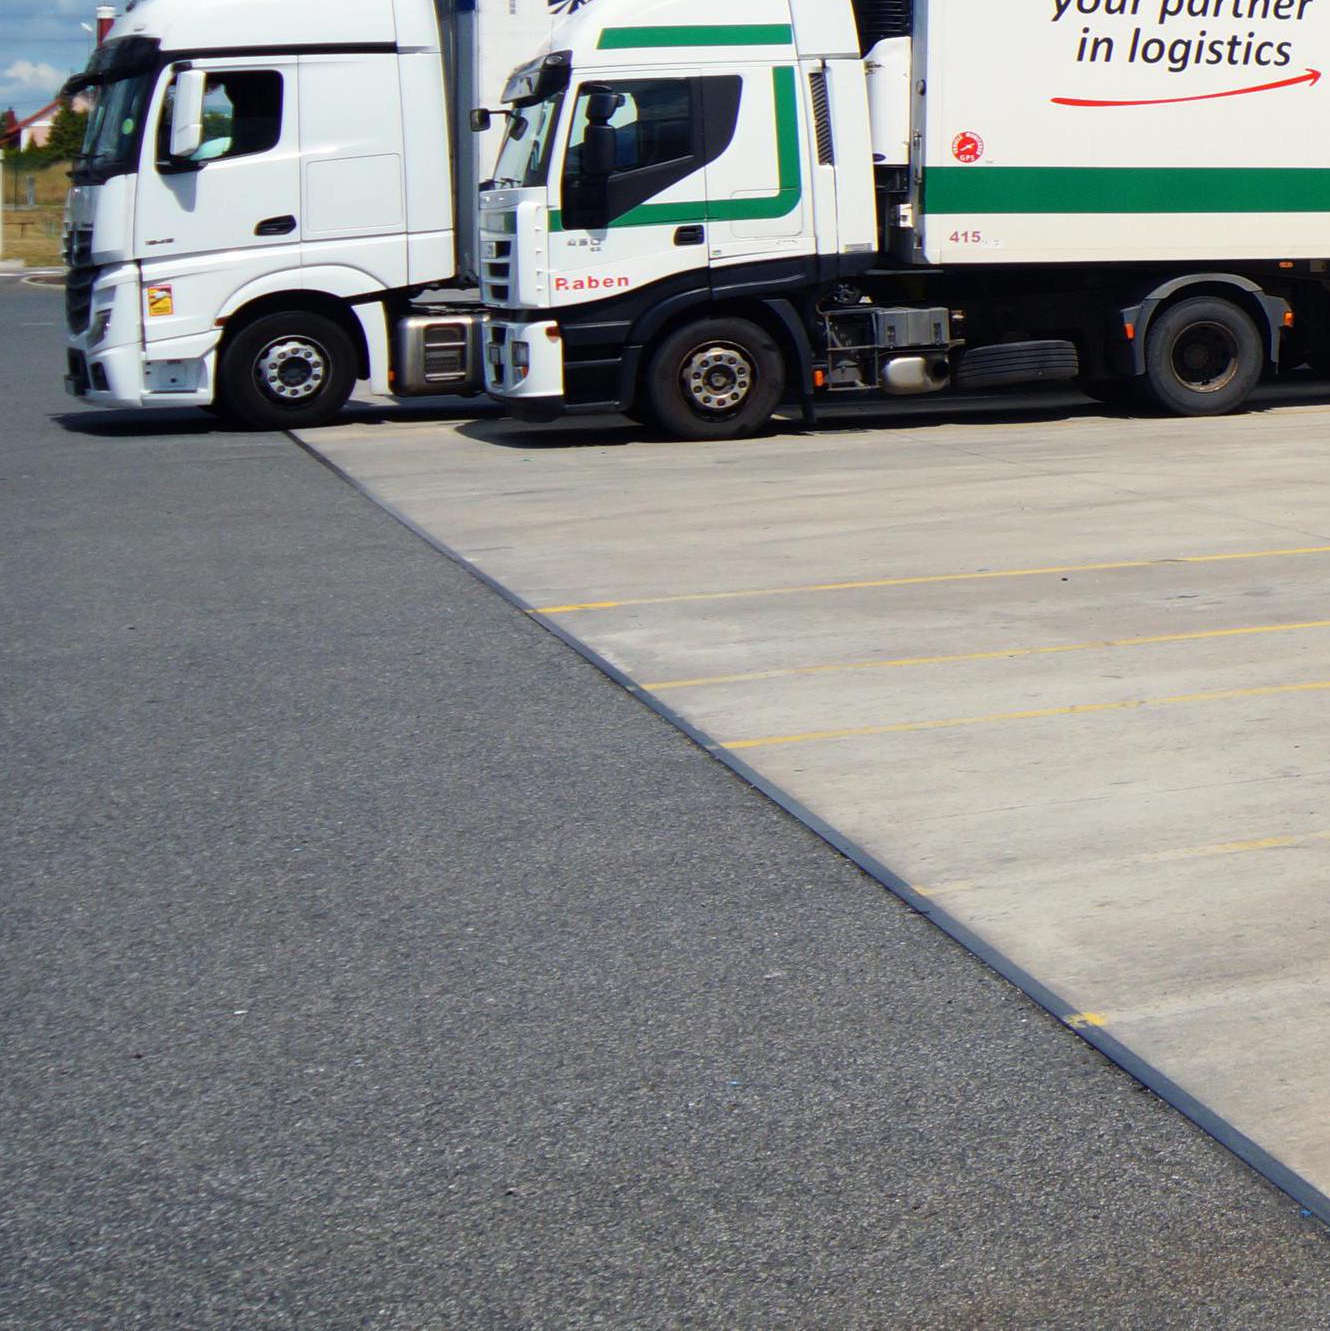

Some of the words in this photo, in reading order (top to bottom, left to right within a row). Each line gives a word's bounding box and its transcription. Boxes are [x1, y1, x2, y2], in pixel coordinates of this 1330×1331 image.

[1075, 26, 1115, 63] in
[1127, 27, 1294, 73] logistics
[948, 230, 982, 243] 415
[554, 275, 630, 291] Raben
